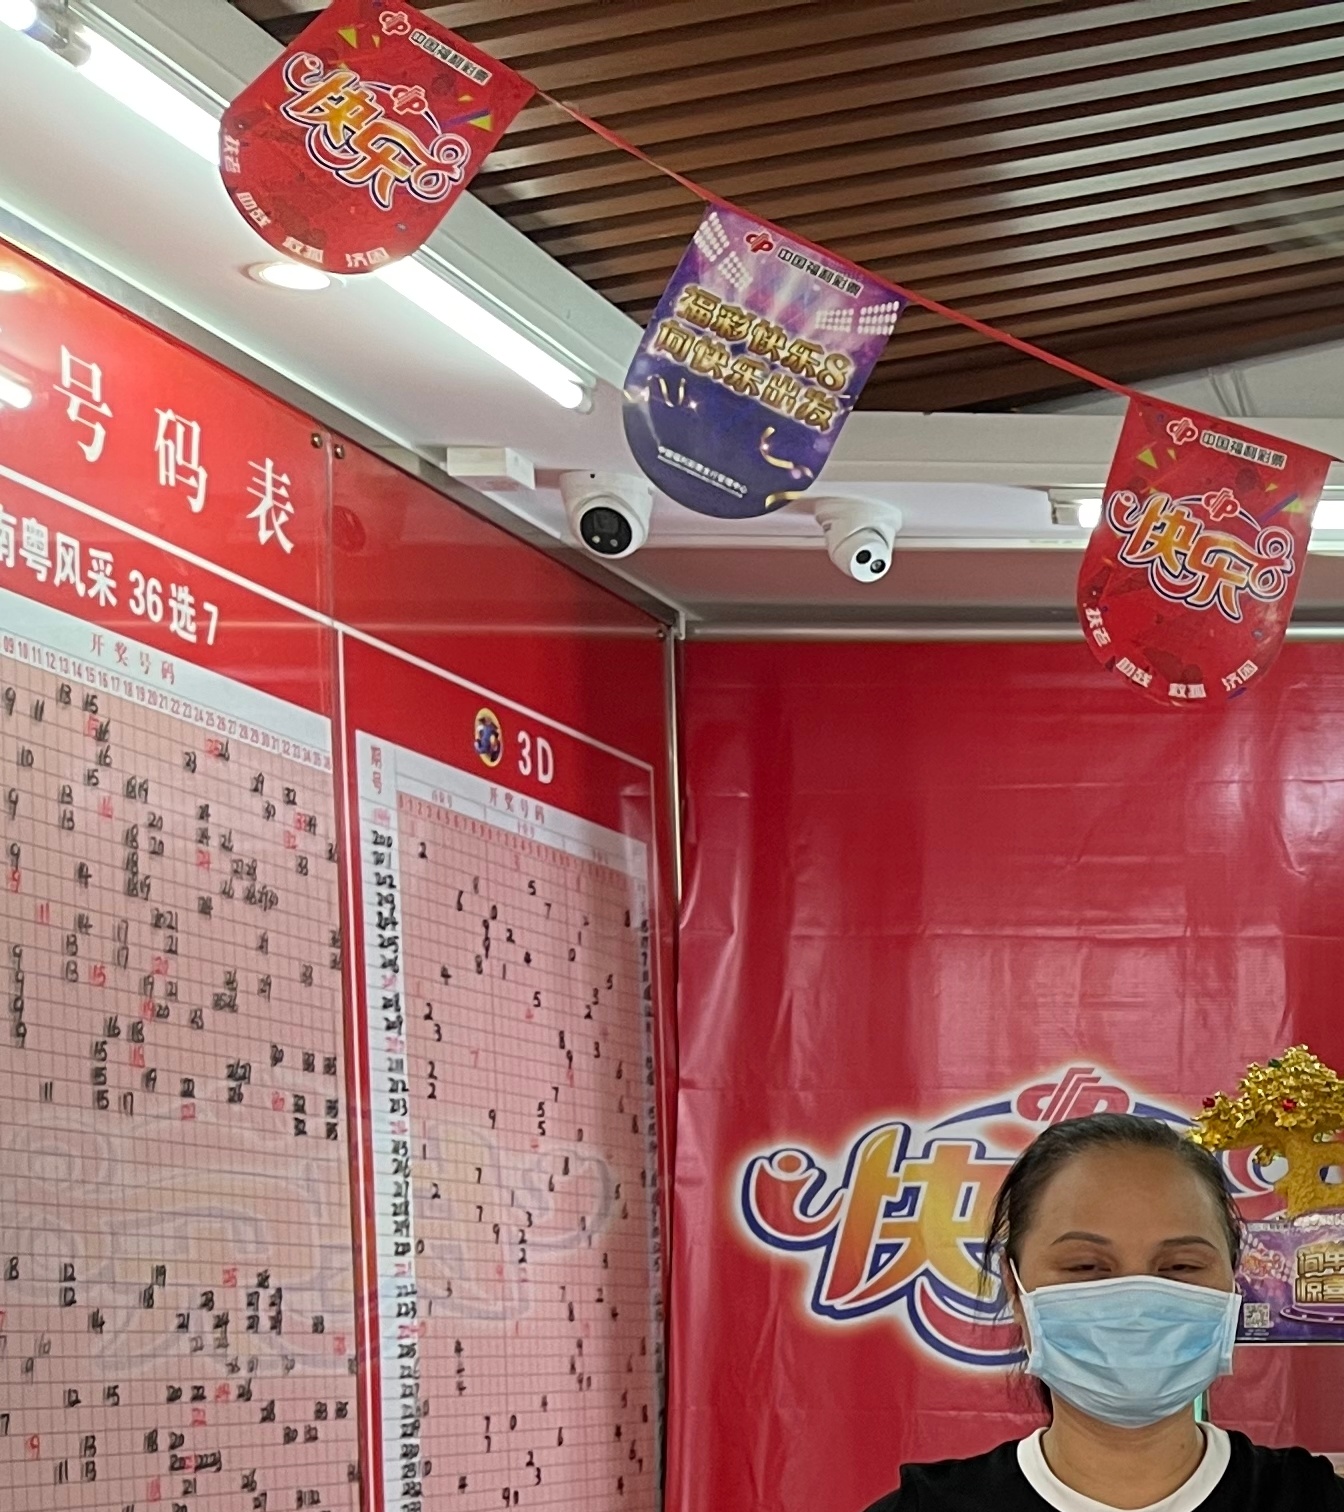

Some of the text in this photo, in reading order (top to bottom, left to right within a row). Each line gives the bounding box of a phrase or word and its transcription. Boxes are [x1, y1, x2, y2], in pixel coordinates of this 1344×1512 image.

[652, 319, 840, 433] 向快乐出发
[674, 285, 852, 392] 福彩快乐8
[53, 345, 296, 555] 号码表
[1200, 430, 1288, 470] 中国福利彩票
[129, 569, 219, 646] 36选7
[517, 730, 555, 784] 3D
